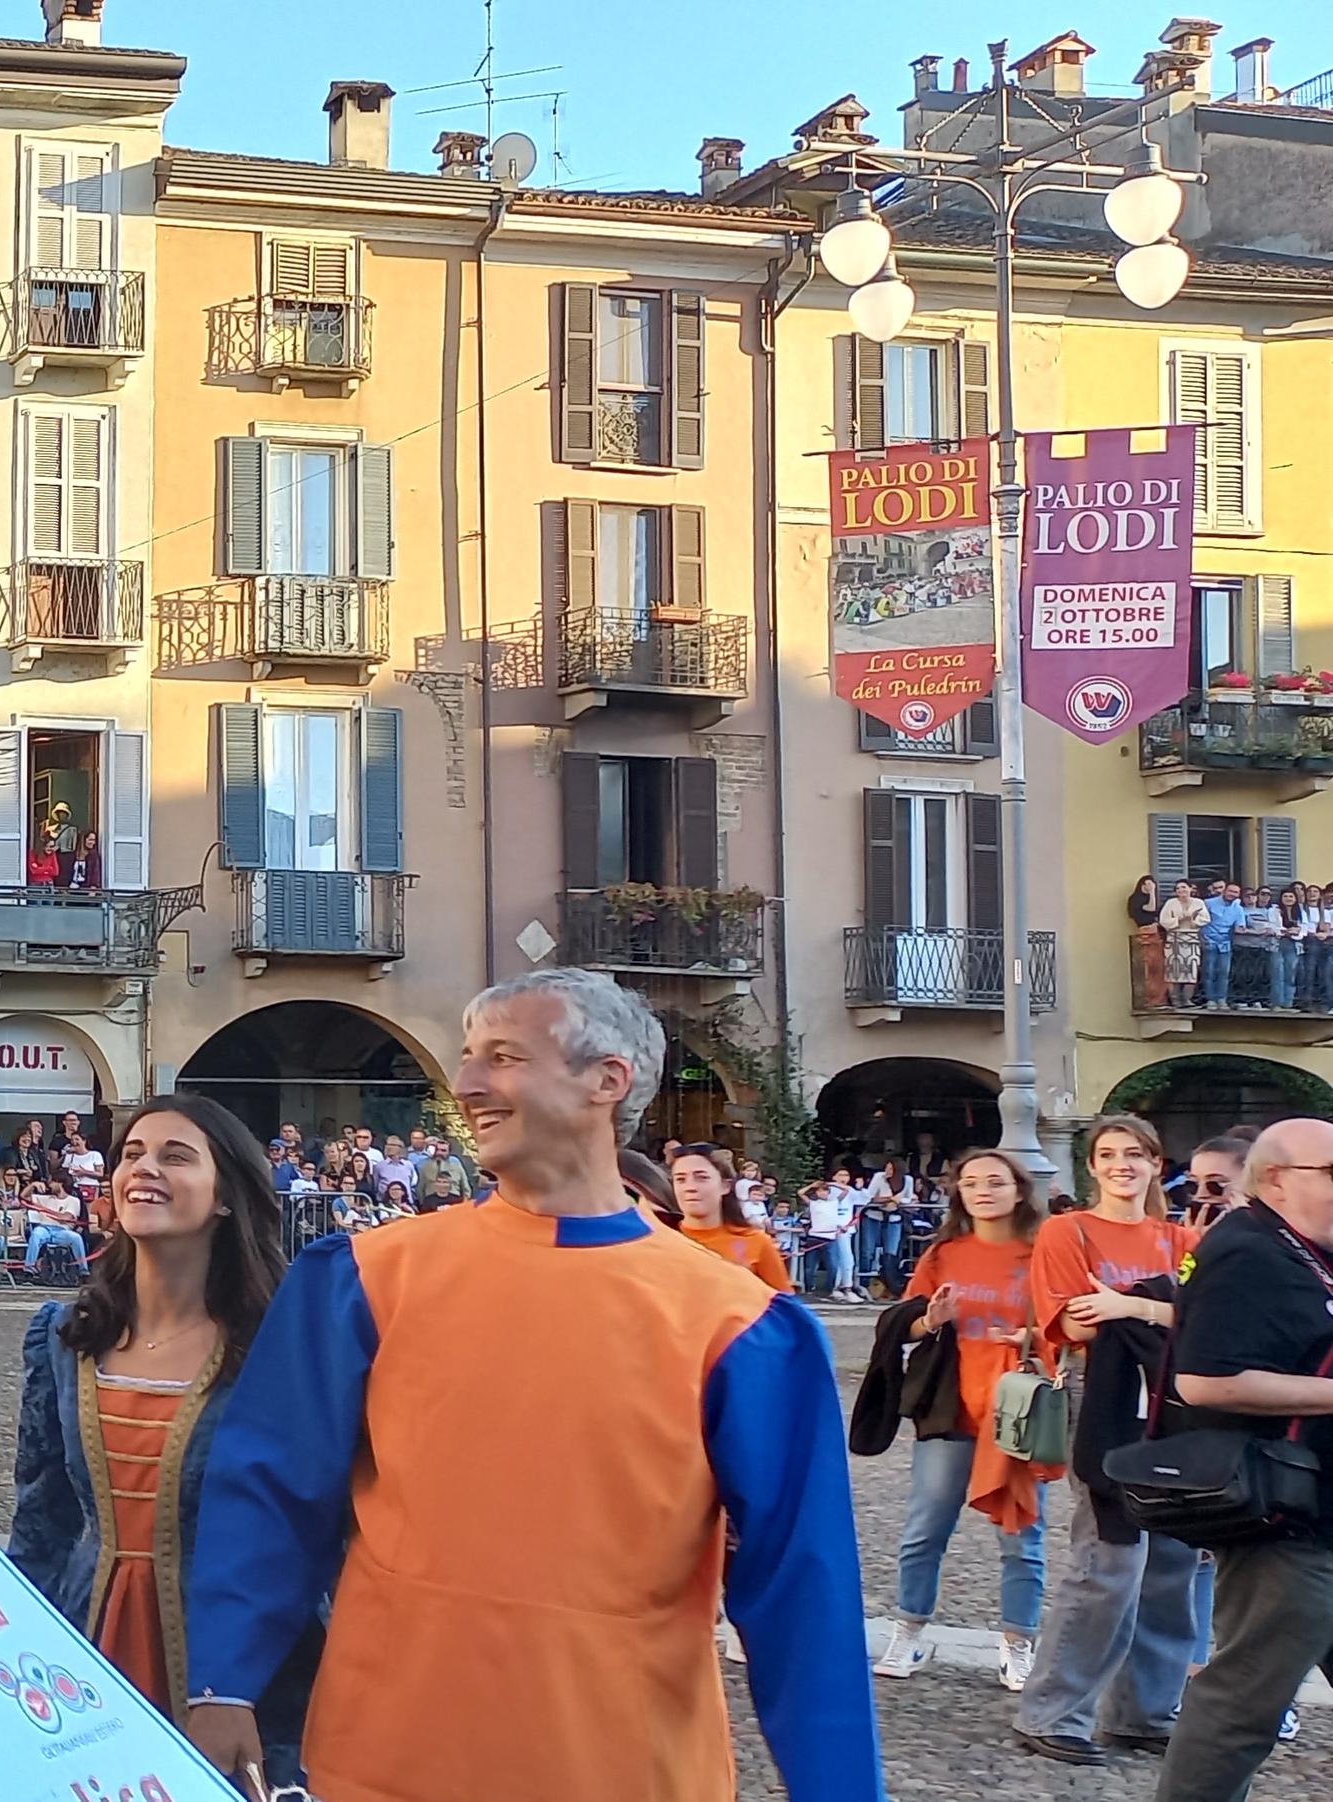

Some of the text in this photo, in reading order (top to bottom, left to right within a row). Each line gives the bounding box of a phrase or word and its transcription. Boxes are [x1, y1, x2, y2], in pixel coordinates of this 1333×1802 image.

[840, 457, 979, 490] PALIO DI
[841, 482, 979, 529] LODI
[1034, 479, 1181, 509] PALIO DI
[1033, 508, 1180, 554] LODI
[1043, 586, 1166, 604] DOMENICA
[1043, 607, 1165, 624] 2 OTTOBRE
[1047, 628, 1159, 644] ORE 15.00
[865, 652, 966, 673] La Cursa
[852, 672, 982, 700] dei Puledrin
